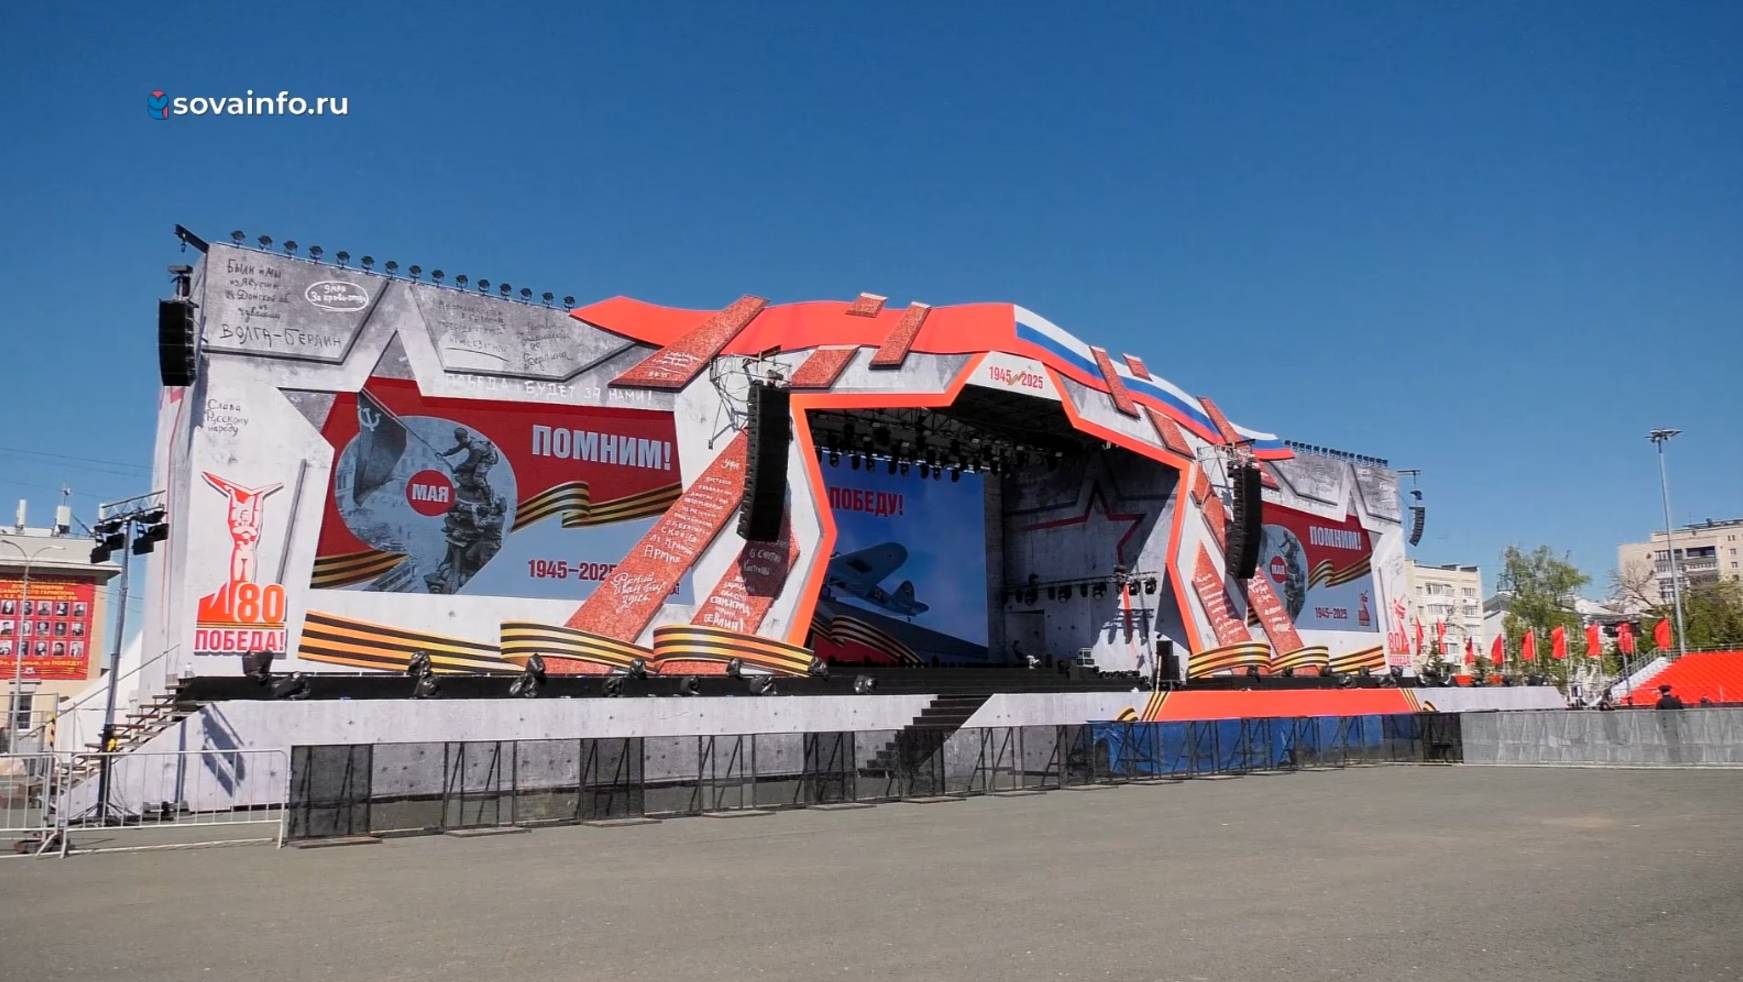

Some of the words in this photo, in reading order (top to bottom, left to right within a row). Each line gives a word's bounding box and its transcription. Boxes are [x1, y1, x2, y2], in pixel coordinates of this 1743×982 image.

[531, 424, 672, 471] ПОМНИМ!
[412, 484, 449, 503] МАЯ
[828, 487, 904, 517] ПОБЕДУ!
[1309, 525, 1361, 550] ПОМНИМ!
[237, 583, 285, 624] 80
[194, 629, 286, 652] ПОБЕДА!
